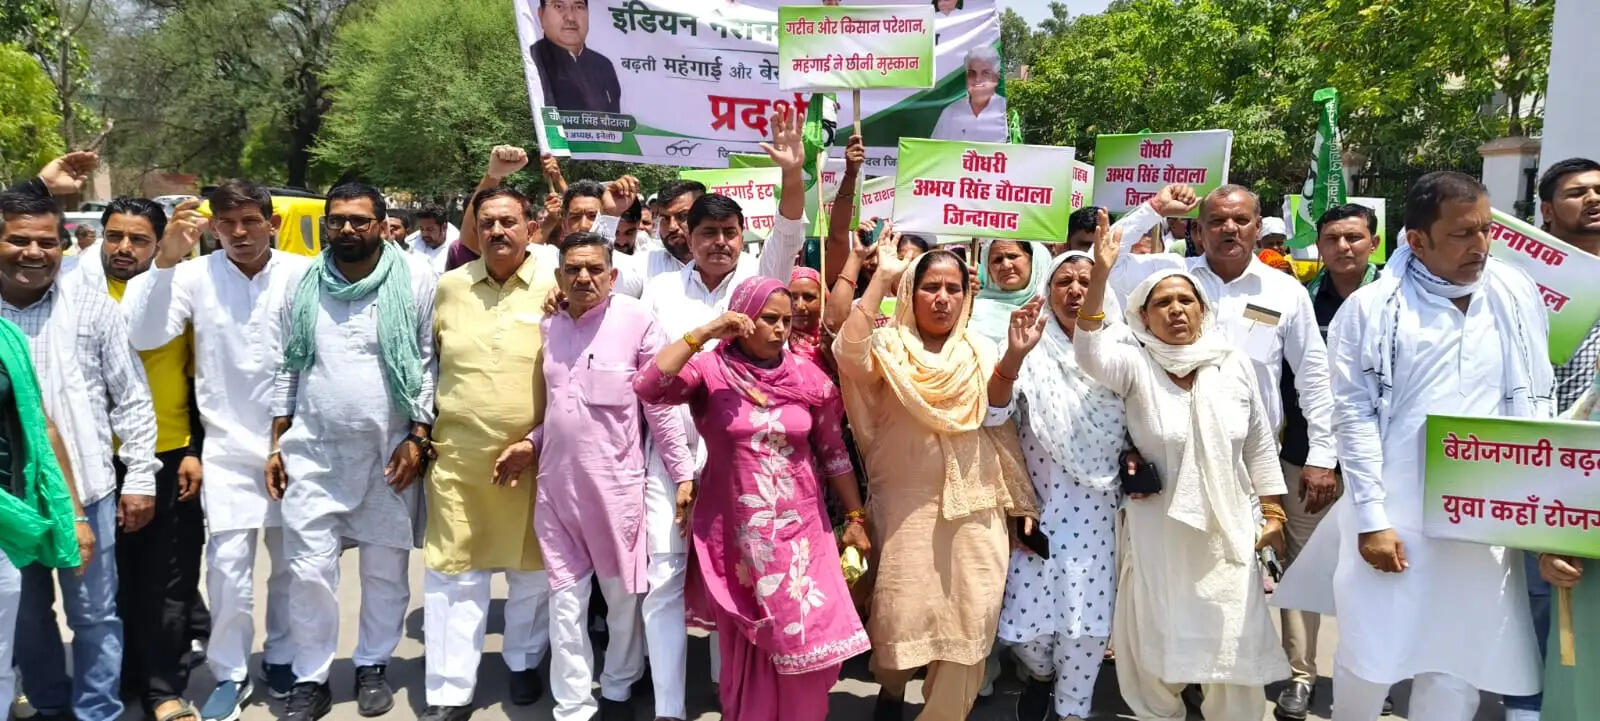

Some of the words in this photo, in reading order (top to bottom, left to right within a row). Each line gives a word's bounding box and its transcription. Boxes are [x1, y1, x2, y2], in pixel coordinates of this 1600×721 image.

[608, 0, 698, 37] इंडियन
[786, 18, 814, 36] गरीब
[840, 16, 880, 35] किसान
[883, 16, 926, 35] परेशान,
[621, 57, 656, 72] बढ़ती
[662, 54, 722, 81] महंगाई
[729, 64, 751, 80] और
[792, 55, 831, 73] महंगाई
[833, 54, 843, 71] ने
[846, 53, 873, 71] छीनी
[876, 56, 919, 76] मुस्कान
[582, 113, 598, 126] सिंह
[1140, 139, 1173, 159] चौधरी
[962, 150, 1008, 174] चौधरी
[1106, 167, 1135, 183] अभय
[1137, 163, 1160, 183] सिंह
[1163, 163, 1207, 184] चौटाला
[913, 178, 951, 197] अभय
[959, 175, 991, 200] सिंह
[995, 179, 1053, 205] चौटाला
[943, 207, 1019, 230] जिन्दाबाद
[1443, 432, 1553, 467] बेरोजगारी
[1558, 447, 1600, 477] बढ़
[1442, 494, 1486, 524] युवा
[1490, 494, 1539, 526] कहाँ
